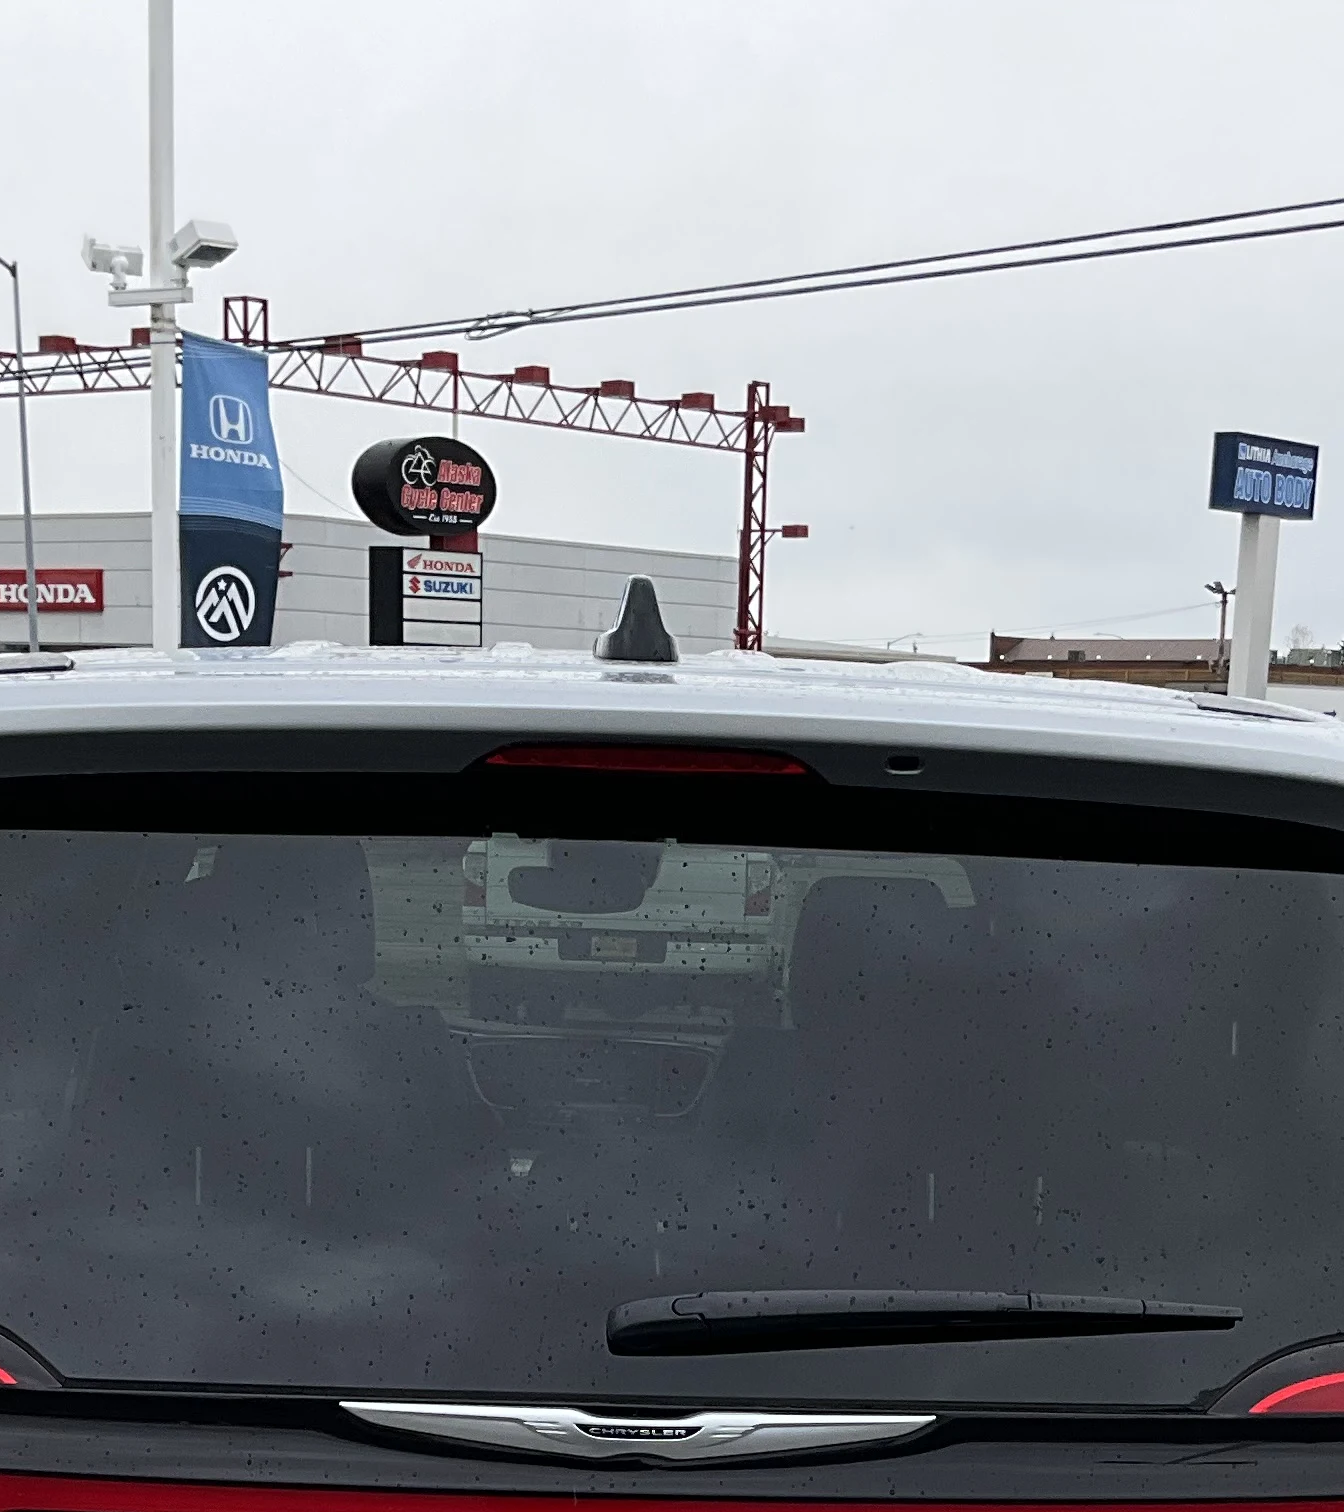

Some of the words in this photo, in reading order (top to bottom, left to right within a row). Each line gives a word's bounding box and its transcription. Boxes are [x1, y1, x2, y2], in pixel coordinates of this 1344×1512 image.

[189, 443, 274, 470] HONDA
[437, 459, 482, 486] Alaska
[400, 484, 438, 510] Cycle
[440, 487, 484, 514] Center
[1234, 466, 1272, 504] AUTO
[1274, 473, 1314, 510] BODY
[422, 560, 476, 573] HONDA
[423, 579, 473, 595] SUZUKI
[588, 1426, 687, 1436] CHRYSLER
